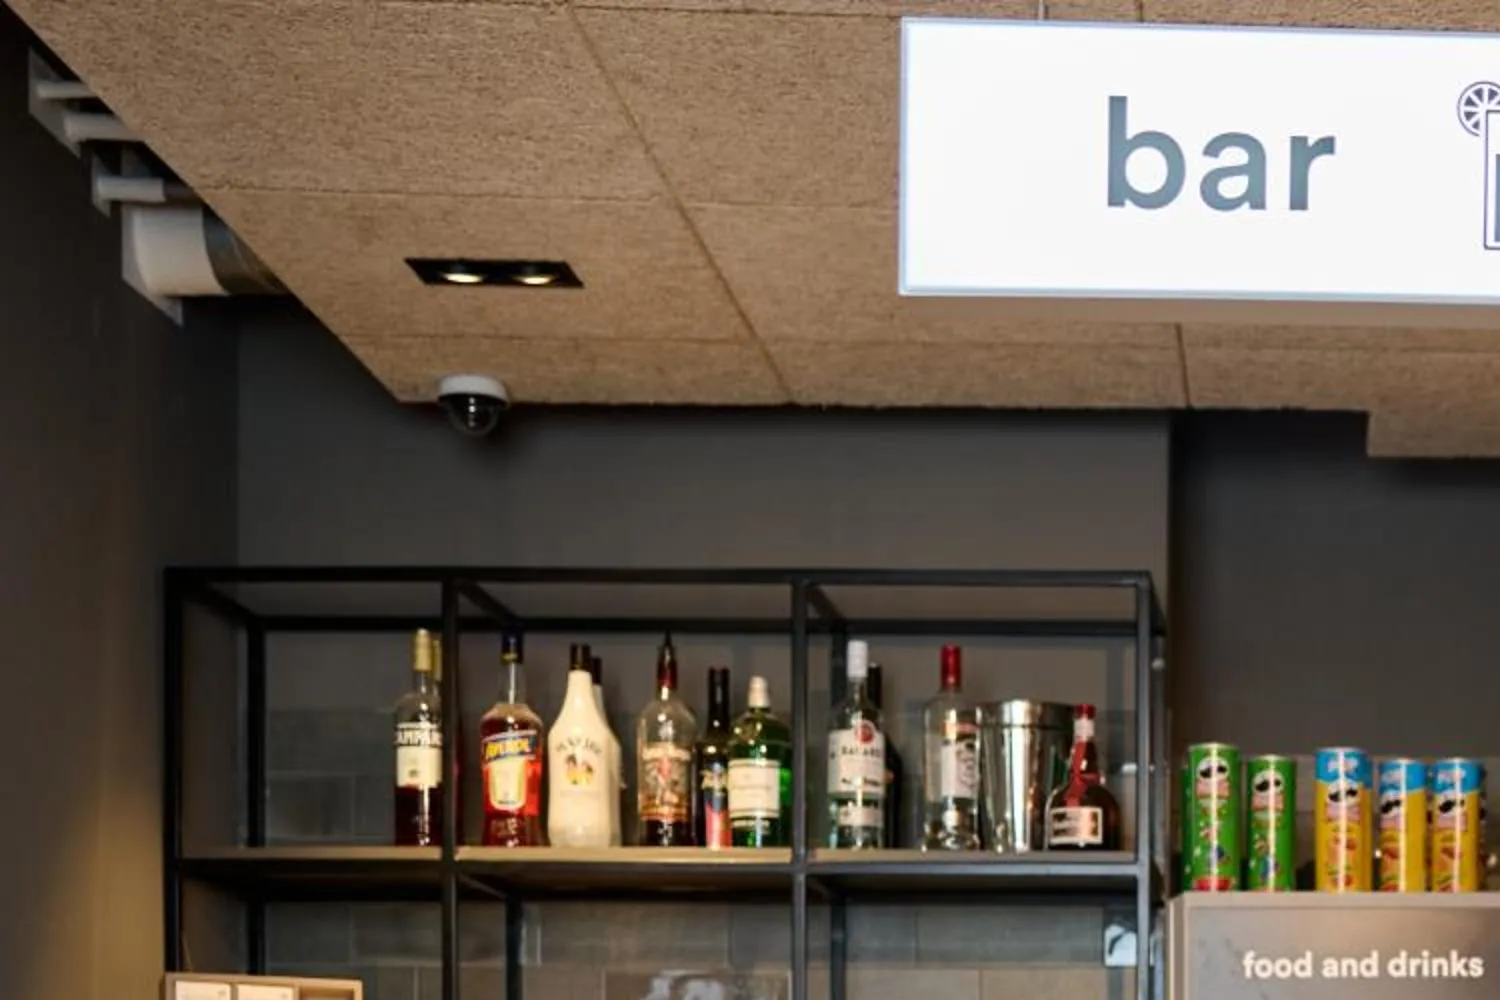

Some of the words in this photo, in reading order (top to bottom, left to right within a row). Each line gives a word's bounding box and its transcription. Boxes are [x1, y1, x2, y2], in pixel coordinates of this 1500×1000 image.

[1107, 95, 1336, 212] bar
[1242, 950, 1313, 978] food
[1321, 950, 1379, 978] and
[1386, 950, 1485, 978] drinks
